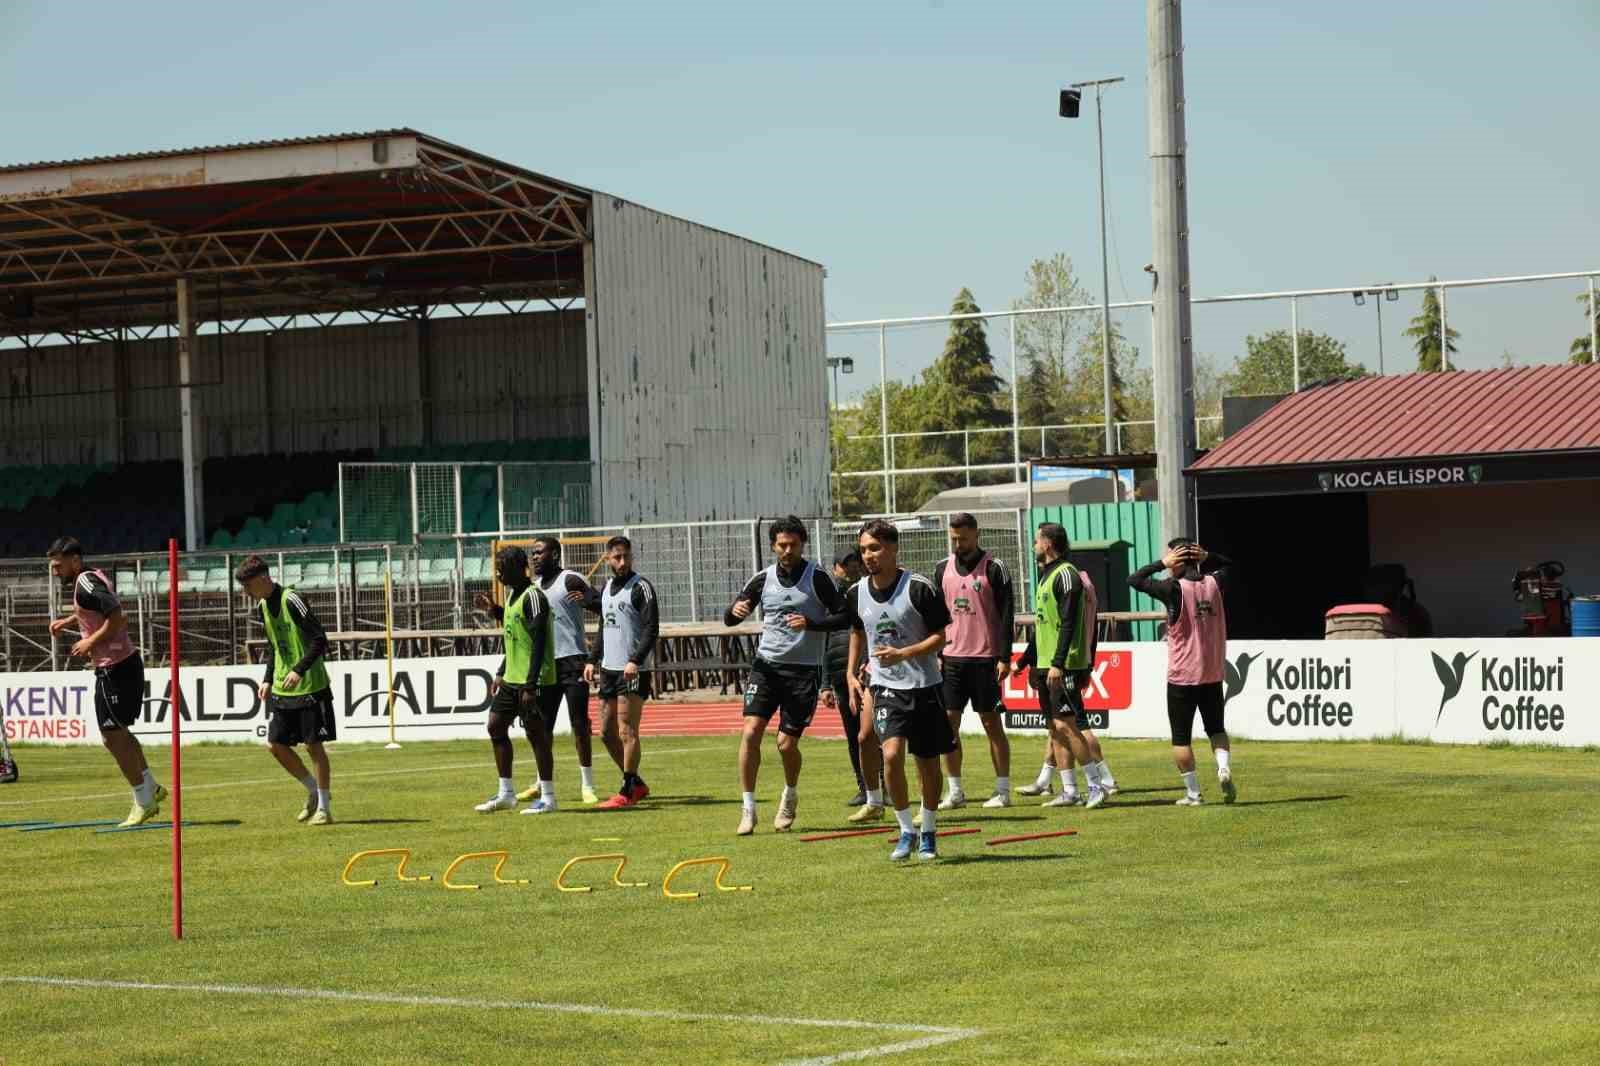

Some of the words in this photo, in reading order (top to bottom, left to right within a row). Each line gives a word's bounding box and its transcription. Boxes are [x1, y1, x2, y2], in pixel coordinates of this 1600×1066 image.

[1266, 658, 1352, 690] Kolibri
[1481, 657, 1564, 691] Kolibri
[6, 686, 88, 716] KENT
[344, 668, 494, 717] HALD
[1011, 713, 1047, 726] MUTFA
[1267, 693, 1353, 727] Coffee
[1482, 695, 1565, 732] Coffee
